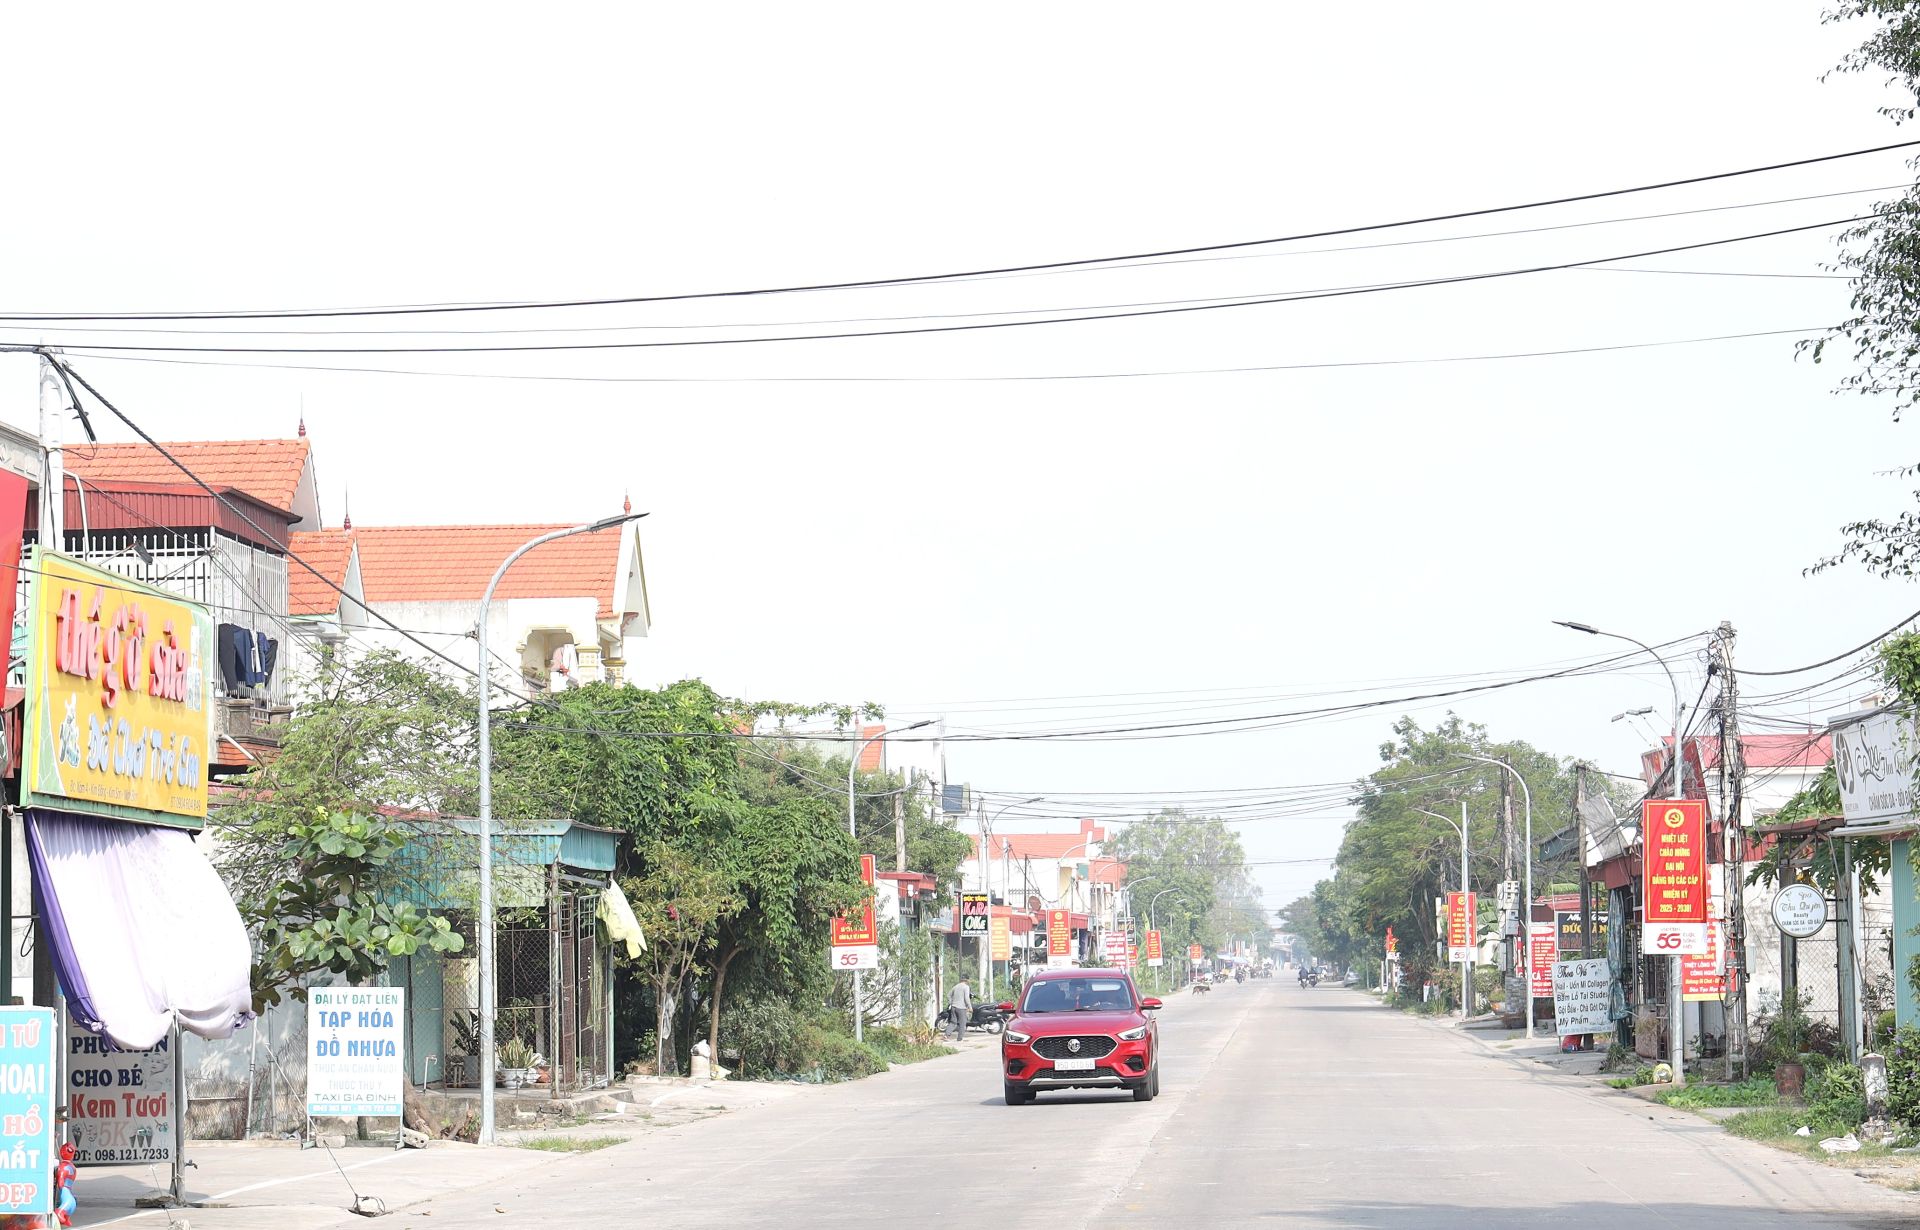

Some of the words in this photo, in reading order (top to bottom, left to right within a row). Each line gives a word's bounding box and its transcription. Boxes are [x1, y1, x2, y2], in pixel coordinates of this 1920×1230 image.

[178, 735, 199, 789] Em
[1660, 904, 1673, 913] 2025
[1657, 933, 1682, 949] 5G
[840, 954, 859, 966] 5G
[315, 994, 332, 1007] ĐẠI
[319, 1011, 352, 1032] TẠP
[358, 1008, 394, 1028] HÓA
[316, 1033, 340, 1057] ĐỒ
[347, 1039, 396, 1060] NHỰA
[71, 1069, 113, 1087] CHO
[118, 1064, 143, 1087] BÉ
[71, 1093, 116, 1118] Kem
[122, 1092, 167, 1118] Tươi
[314, 1093, 340, 1101] TAXI
[343, 1093, 363, 1101] GIA
[98, 1121, 129, 1146] 5K
[95, 1148, 169, 1161] 098.121.7233
